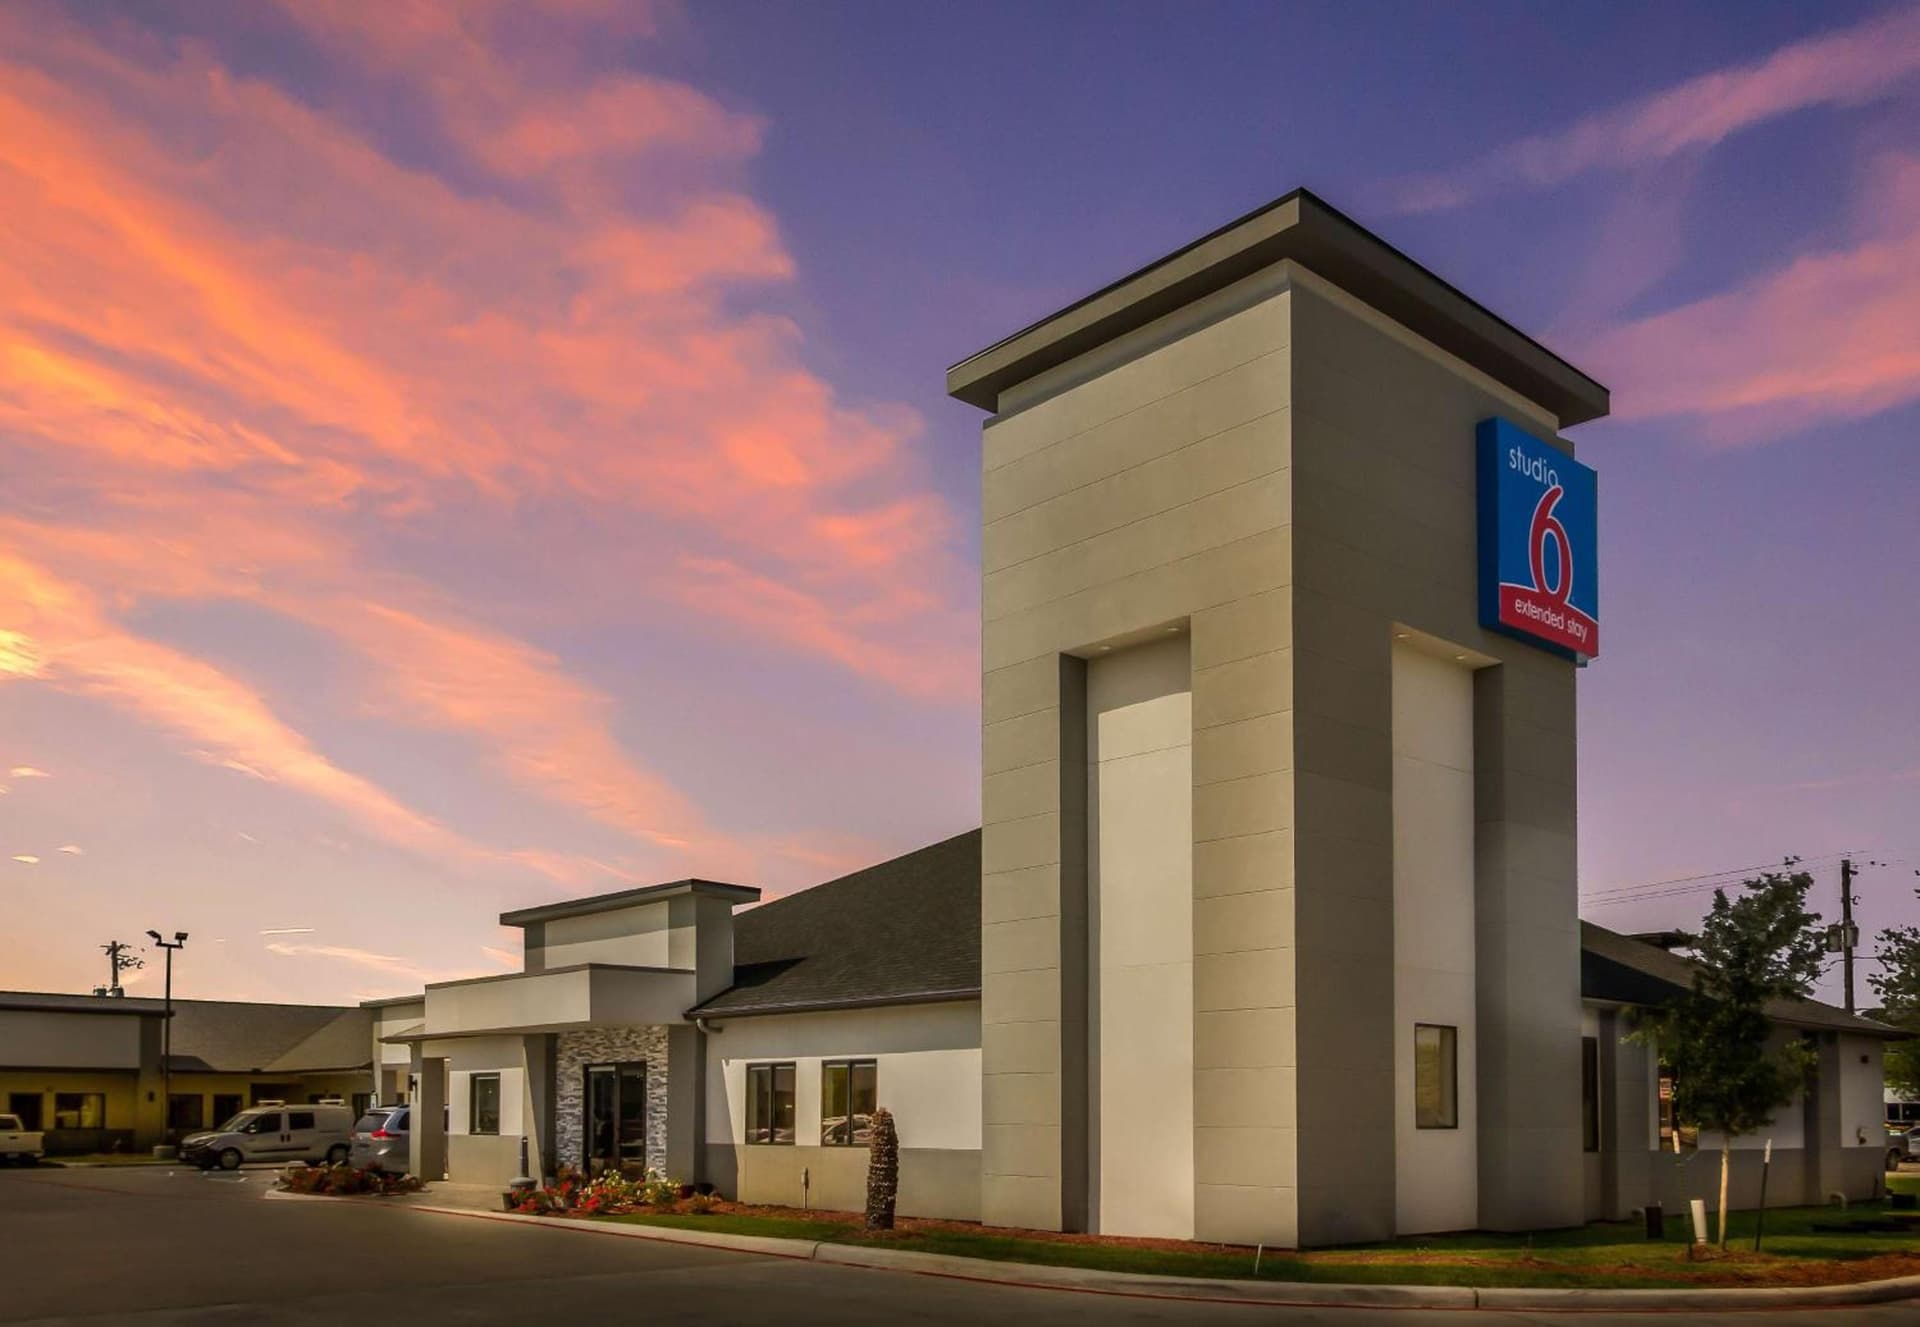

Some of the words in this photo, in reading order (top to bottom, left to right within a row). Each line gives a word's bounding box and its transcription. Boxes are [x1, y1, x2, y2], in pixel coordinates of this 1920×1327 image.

[1509, 446, 1559, 487] studio
[1529, 485, 1573, 602] 6
[1514, 598, 1564, 630] extended
[1567, 617, 1587, 643] stay
